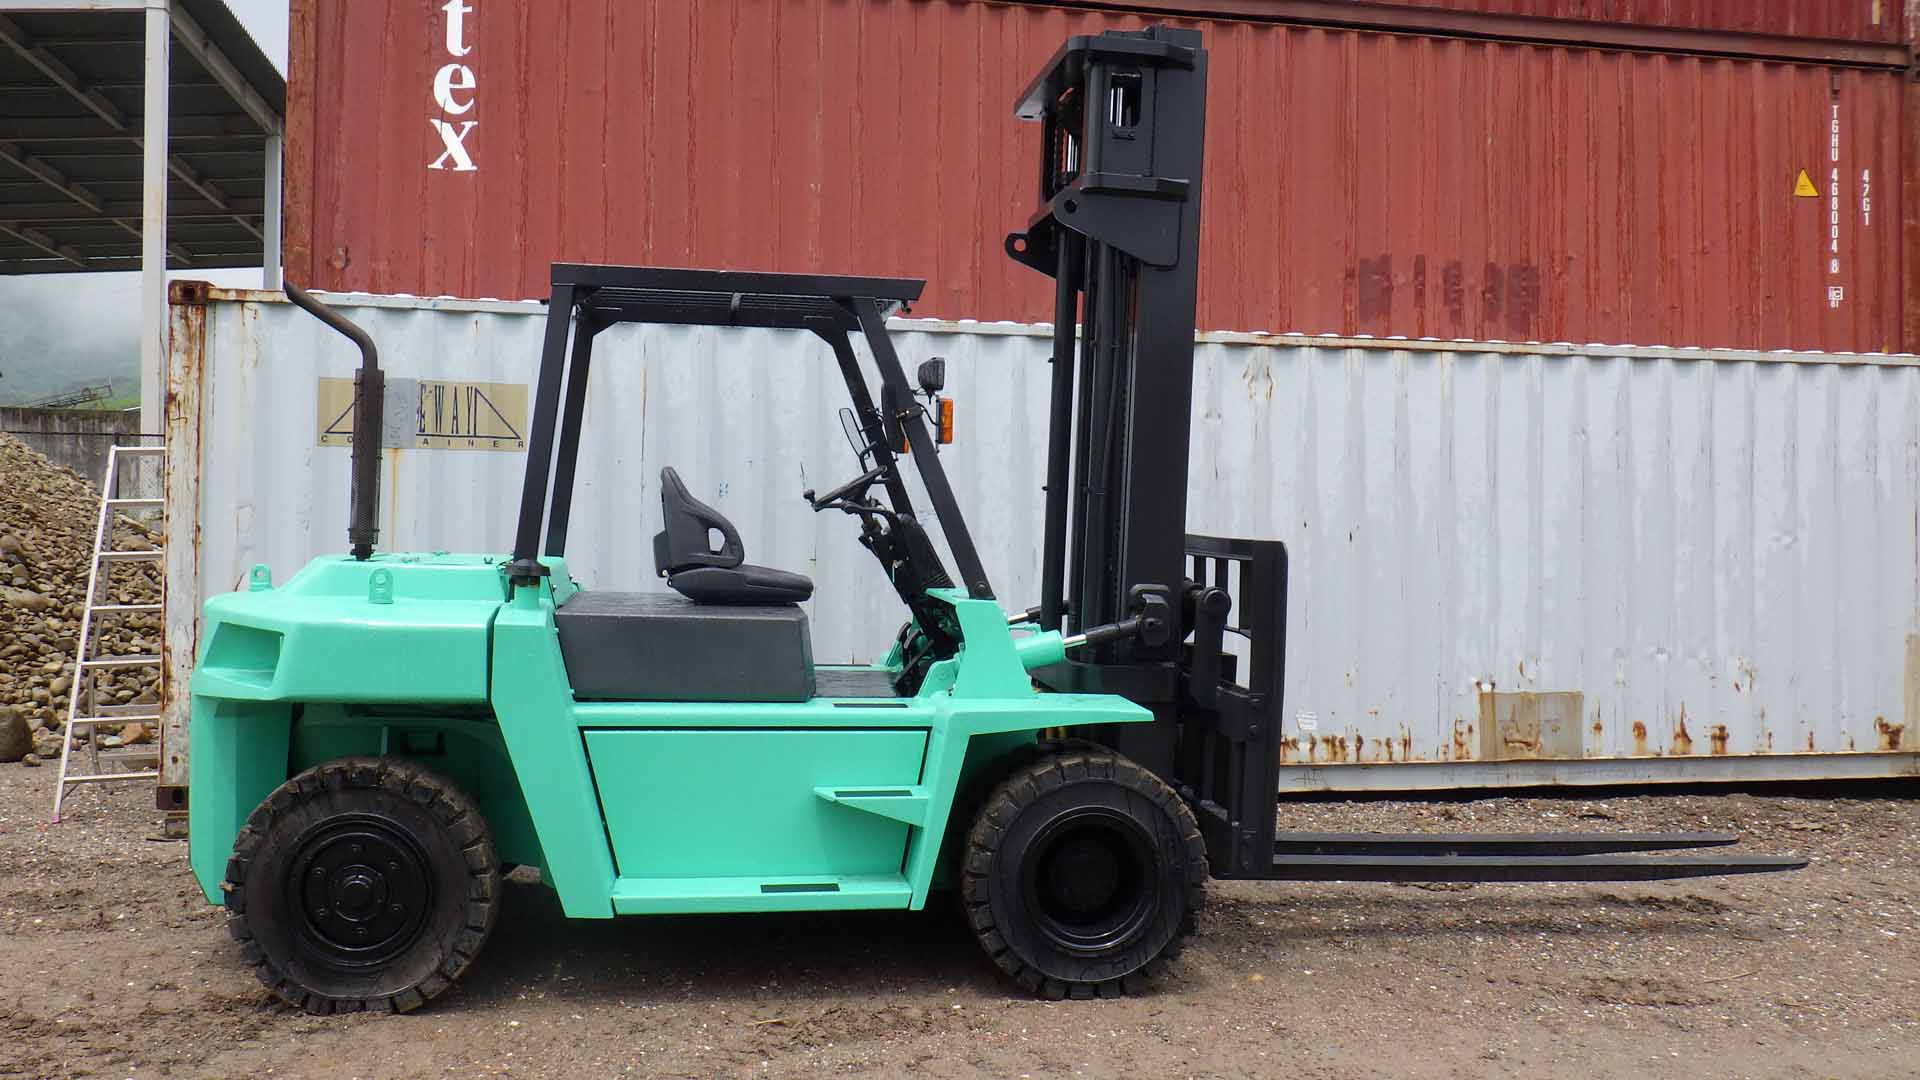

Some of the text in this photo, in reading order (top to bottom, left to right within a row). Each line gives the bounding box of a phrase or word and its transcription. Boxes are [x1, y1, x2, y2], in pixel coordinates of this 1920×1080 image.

[428, 0, 478, 171] tex
[1831, 105, 1840, 273] TGHU 468004 8
[321, 434, 524, 448] COAINER
